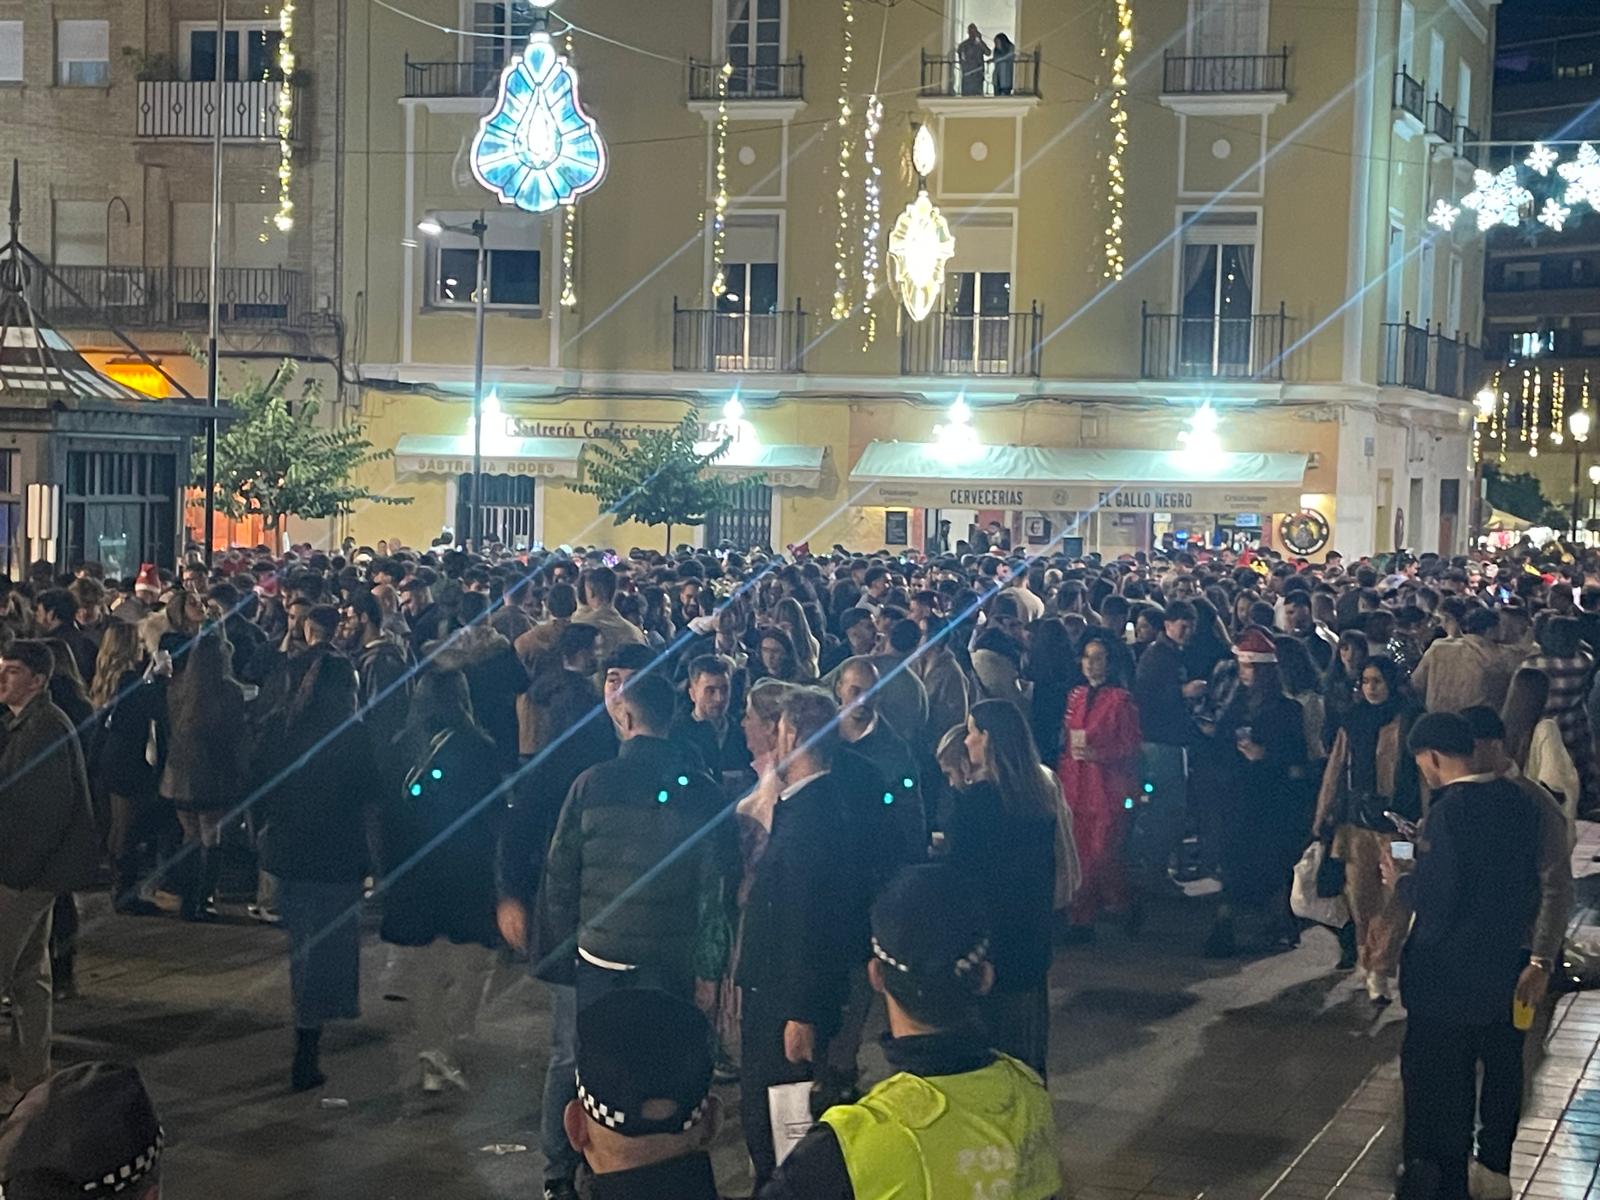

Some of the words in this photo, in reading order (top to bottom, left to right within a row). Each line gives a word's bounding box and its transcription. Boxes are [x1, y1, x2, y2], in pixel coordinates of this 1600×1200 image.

[513, 417, 575, 437] Sastrería
[417, 458, 497, 473] SASTREIA
[506, 461, 555, 474] RODES
[950, 489, 1023, 506] CERVECERIAS
[1098, 492, 1112, 508] EL
[1115, 492, 1151, 508] GALLO
[1154, 492, 1193, 508] NEGRO
